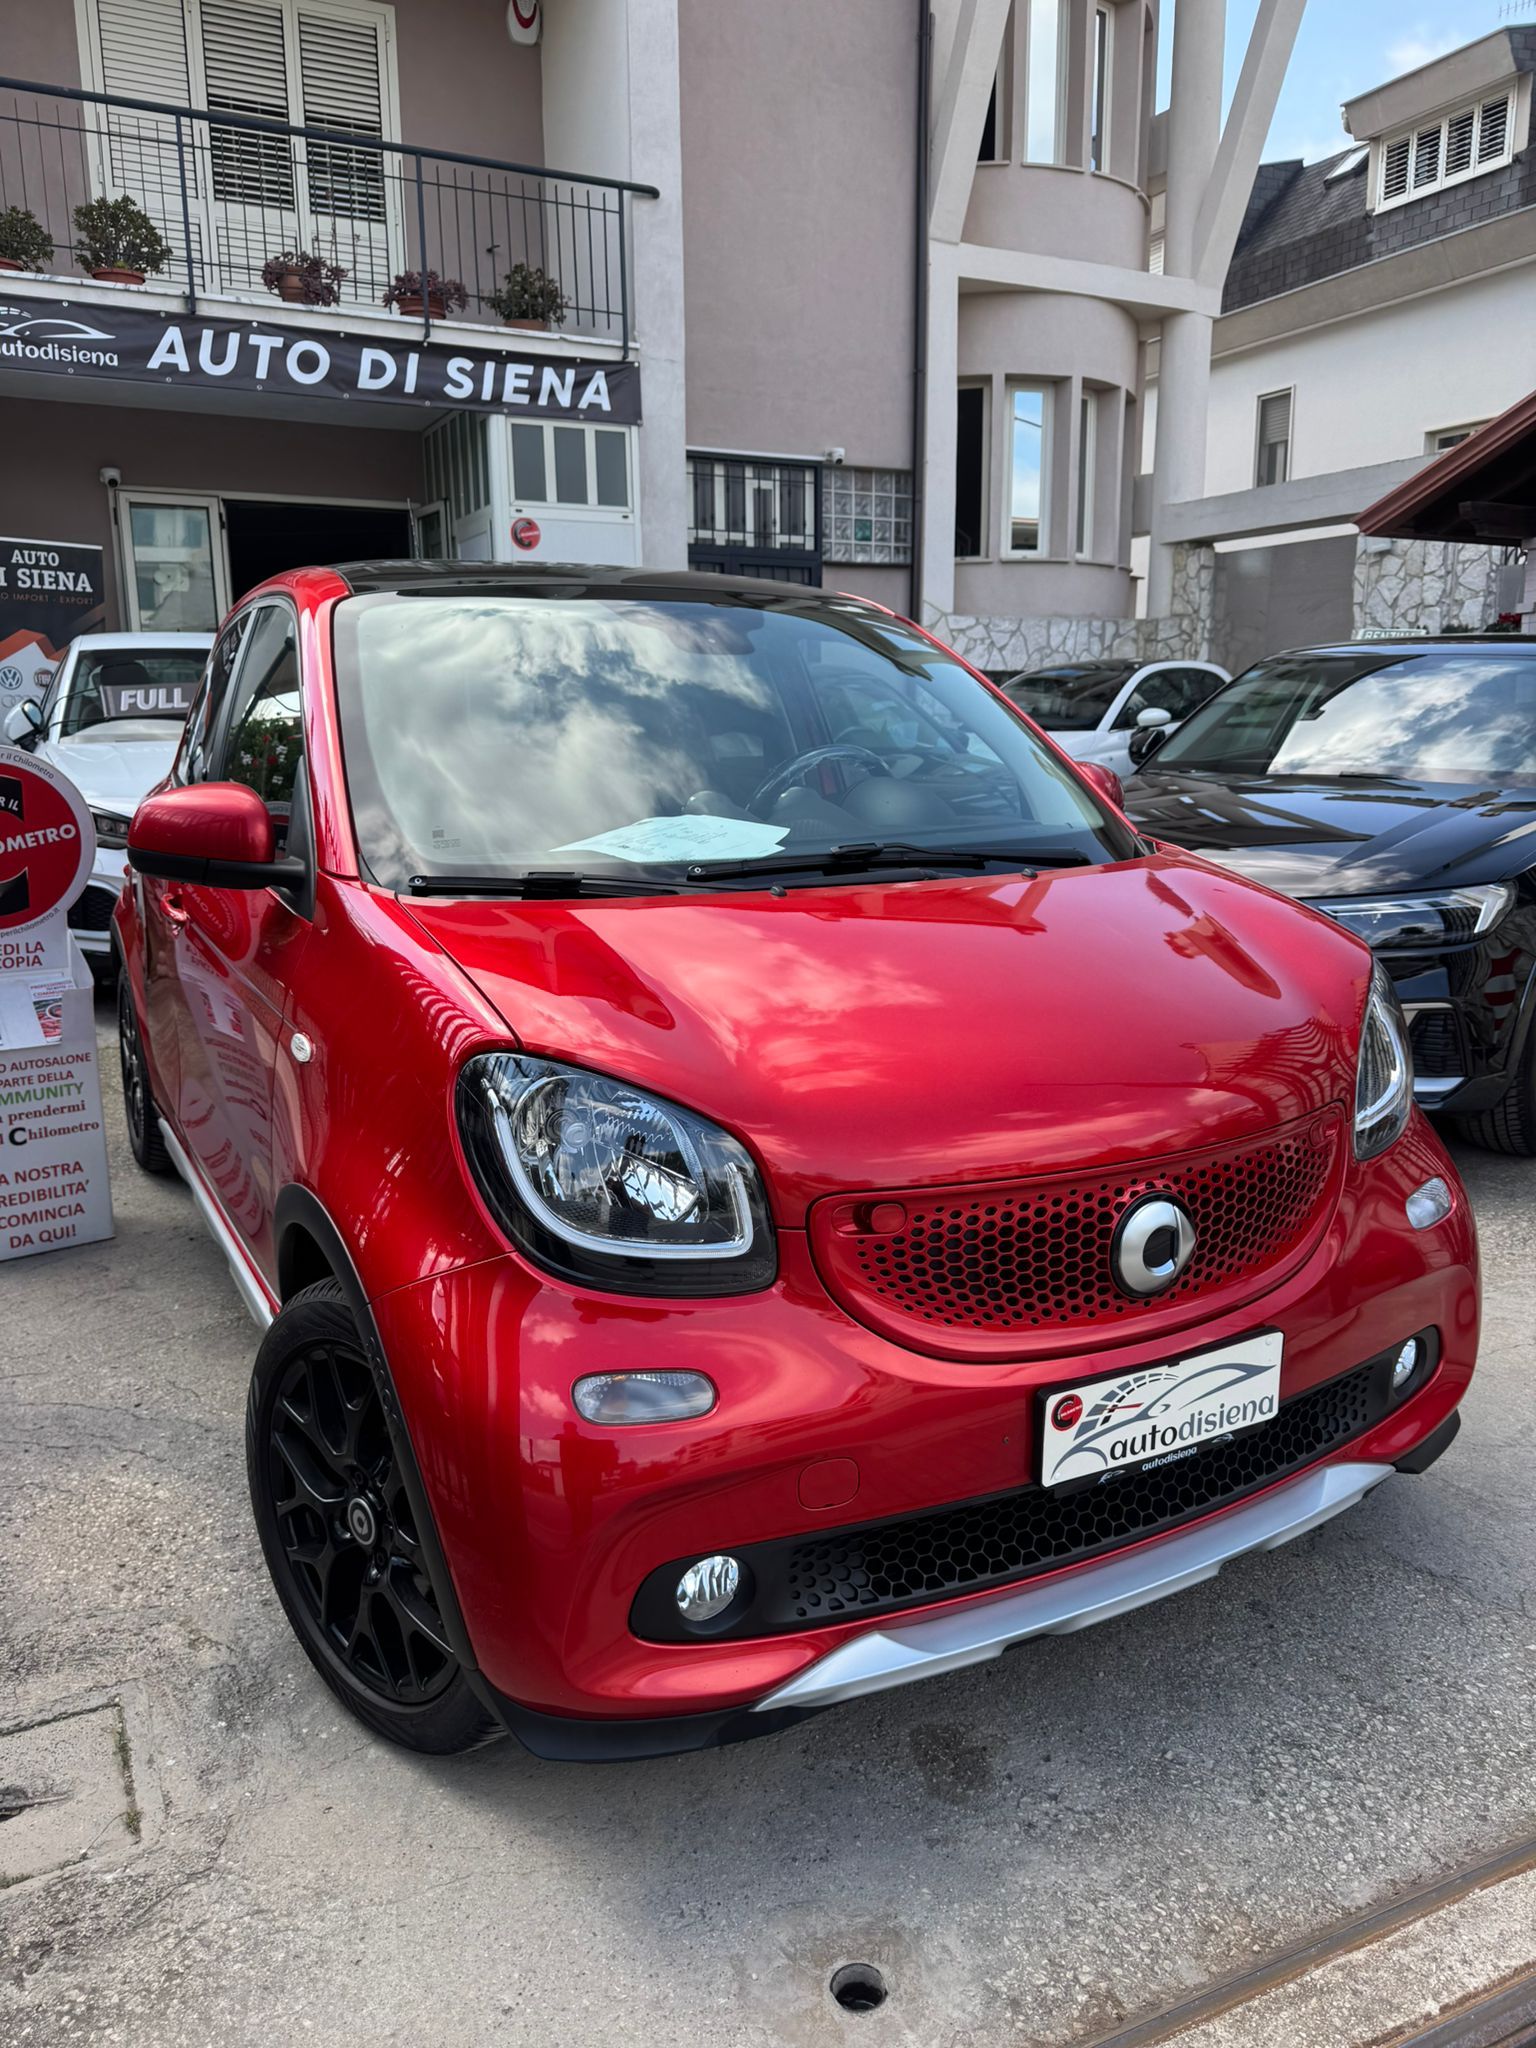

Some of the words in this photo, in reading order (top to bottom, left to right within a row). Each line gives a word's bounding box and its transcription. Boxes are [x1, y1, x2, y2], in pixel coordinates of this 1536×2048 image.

[0, 339, 119, 367] utodisiena
[146, 325, 331, 385] AUTO
[357, 347, 420, 394] DI
[443, 356, 612, 412] SIENA
[11, 549, 60, 567] AUTO
[17, 567, 93, 593] SIENA
[13, 593, 49, 602] IMPORT
[60, 595, 93, 605] EXPORT
[120, 687, 190, 712] FULL
[13, 754, 55, 780] Chilometro
[8, 798, 20, 811] IL
[25, 941, 45, 954] LA
[0, 954, 43, 969] OPIA
[10, 1052, 92, 1072] AUTOSALONE
[37, 1070, 75, 1084] DELLA
[8, 1099, 86, 1126] prendermi
[9, 1120, 99, 1146] Chilometro
[14, 1160, 84, 1184] NOSTRA
[0, 1202, 85, 1230] COMINCIA
[9, 1233, 34, 1249] DA
[39, 1223, 77, 1243] QUI!
[1109, 1394, 1275, 1461] autodisiena
[1142, 1446, 1198, 1472] autodisiena
